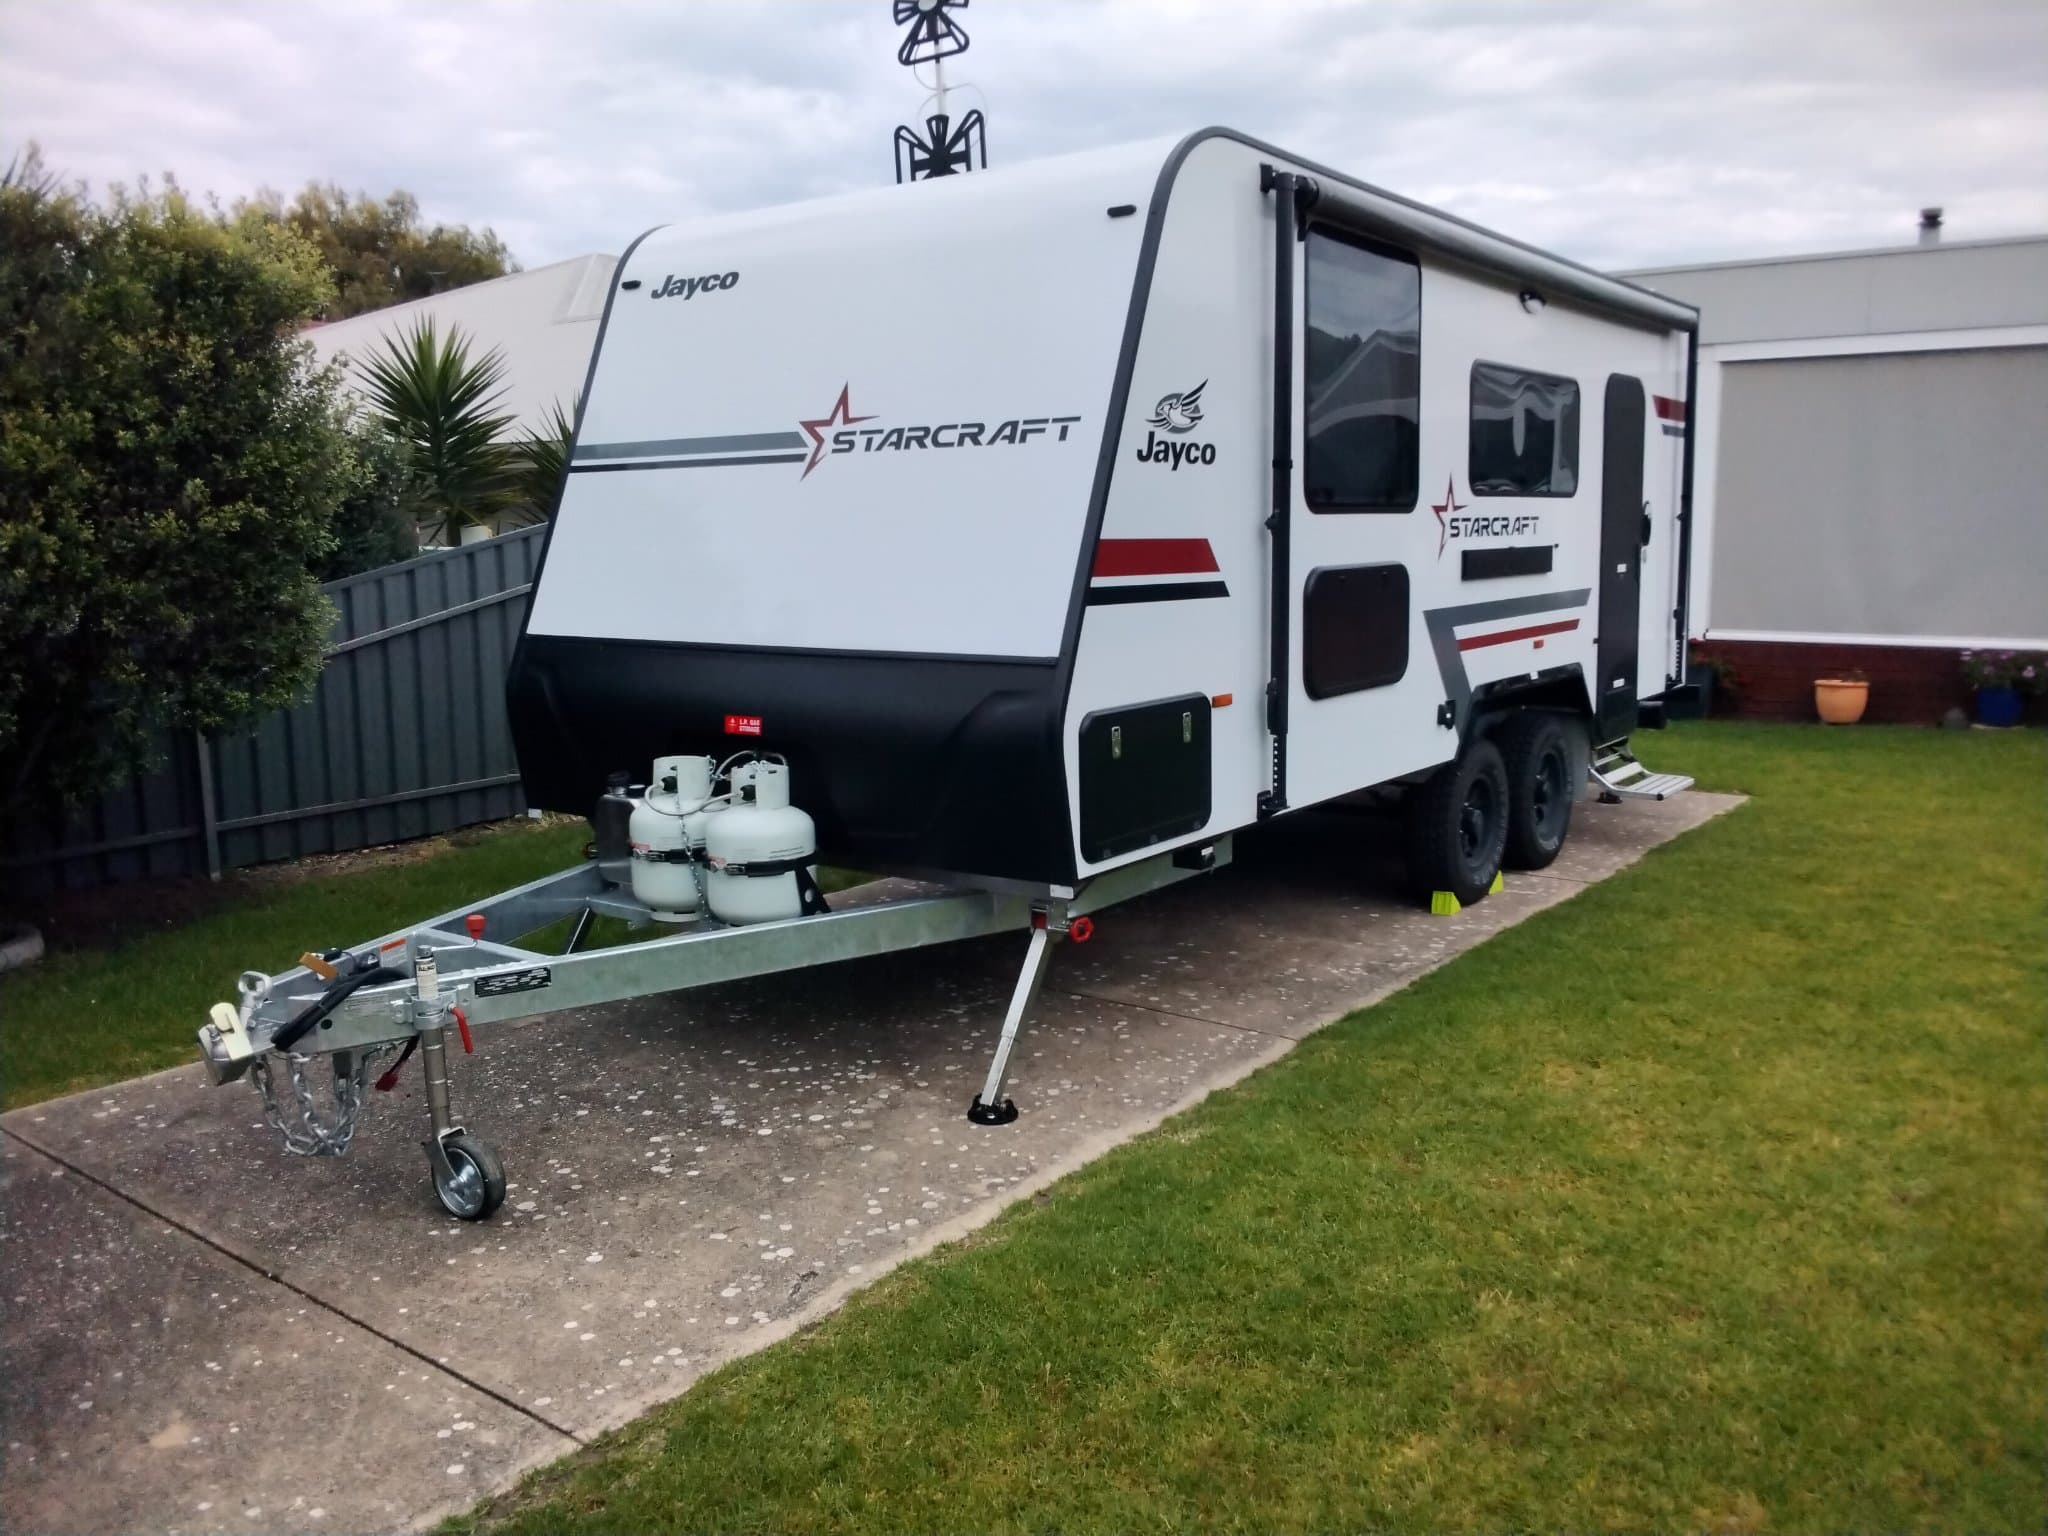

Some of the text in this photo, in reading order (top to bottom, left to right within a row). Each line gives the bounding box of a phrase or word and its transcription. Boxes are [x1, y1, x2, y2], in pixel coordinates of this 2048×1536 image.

[651, 271, 739, 300] Jayco
[831, 416, 1081, 453] STARCRAFT
[1136, 431, 1216, 471] Jayco
[1449, 516, 1539, 538] STARCRAFT
